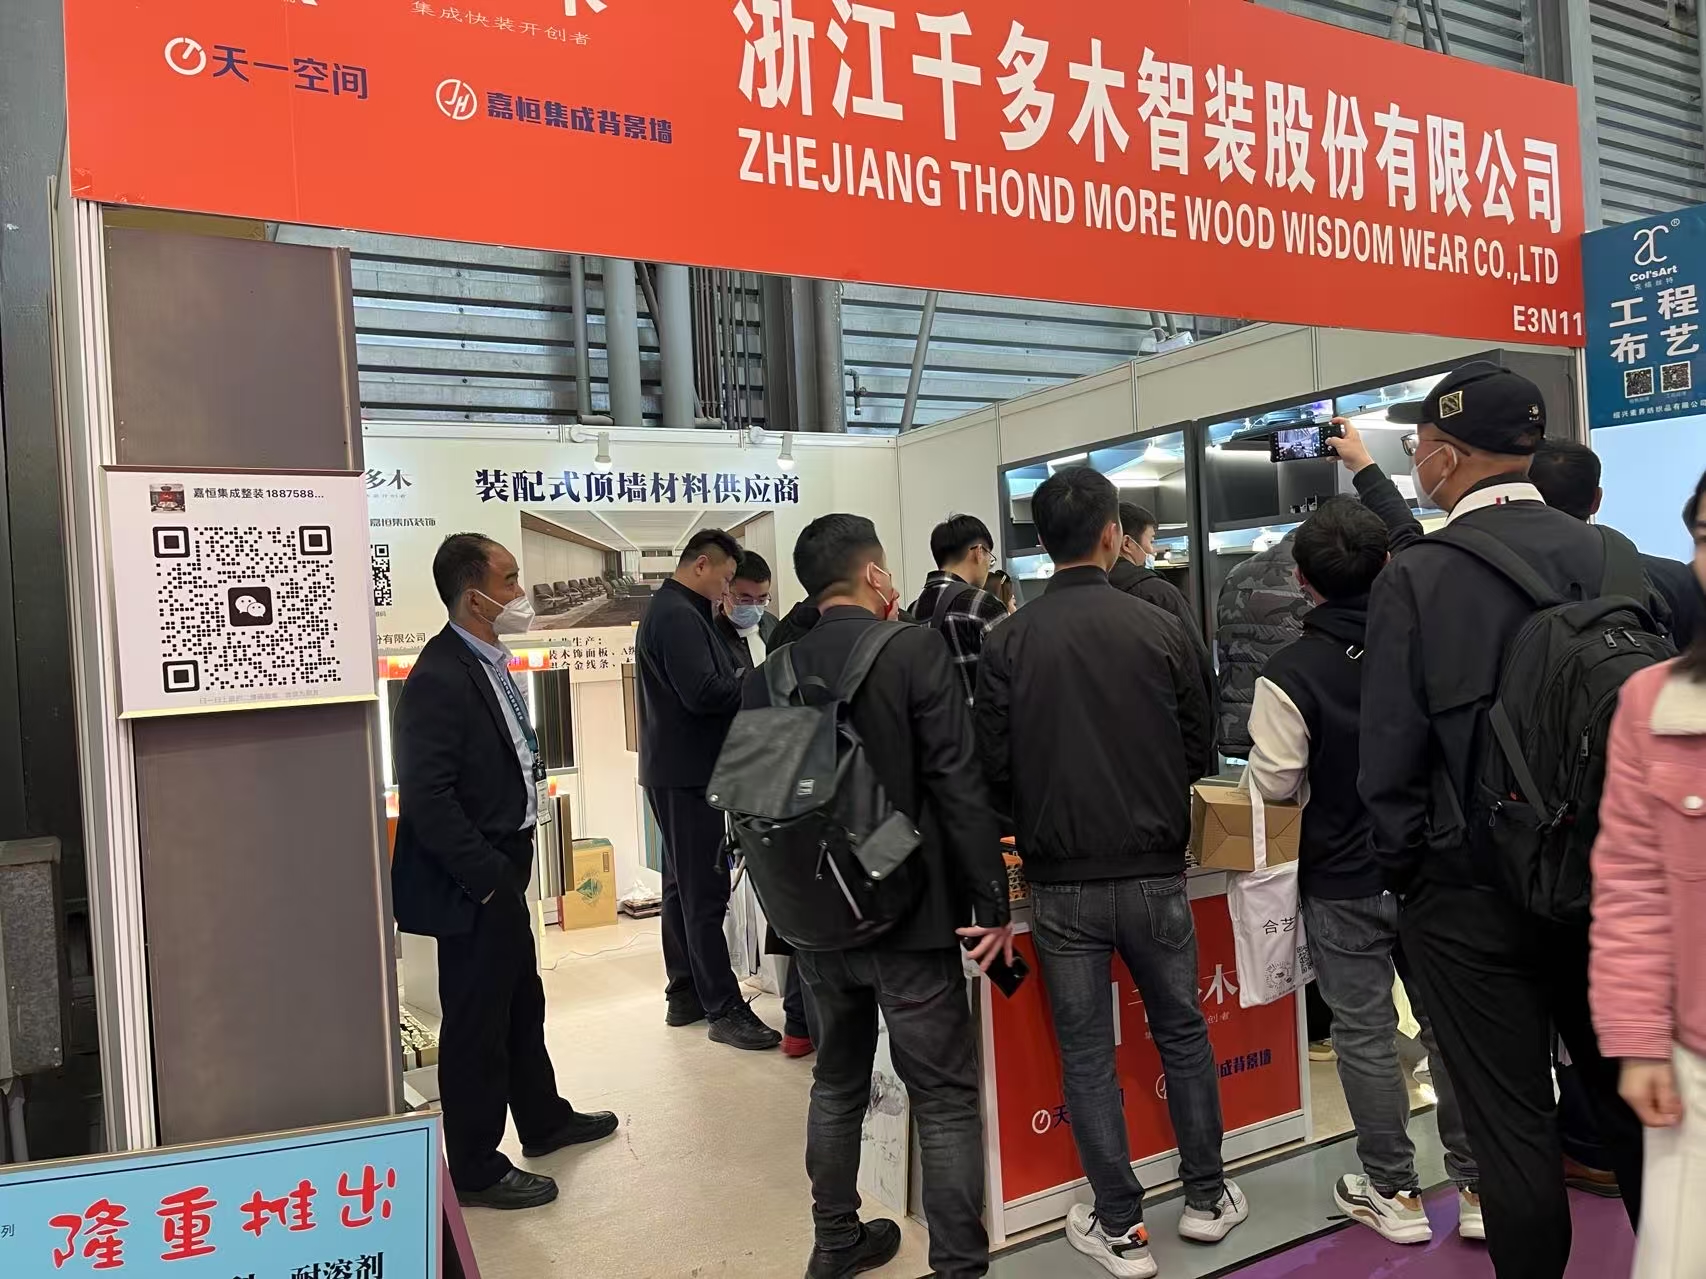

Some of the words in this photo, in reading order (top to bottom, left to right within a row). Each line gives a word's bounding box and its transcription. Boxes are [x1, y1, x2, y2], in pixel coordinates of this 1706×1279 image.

[411, 0, 592, 46] 集成快装开创者
[211, 43, 368, 101] 天一空间
[486, 91, 673, 145] 嘉恒集成背景墙
[733, 0, 1562, 234] 浙江千多木智装股份有限公司
[737, 127, 941, 207] ZHEJIANG
[950, 159, 1075, 225] THOND
[1084, 180, 1177, 239] MORE
[1184, 194, 1275, 250] WOOD
[1281, 209, 1394, 266] WISDOM
[1400, 226, 1469, 275] WEAR
[1629, 264, 1678, 283] Col'sArt
[1512, 304, 1584, 337] E3N11
[1609, 284, 1699, 329] 工程
[1609, 322, 1700, 365] 布艺
[474, 467, 801, 505] 装配式顶墙材料供应商
[1216, 1048, 1273, 1079] 成背景墙
[48, 1164, 398, 1271] 隆重推出
